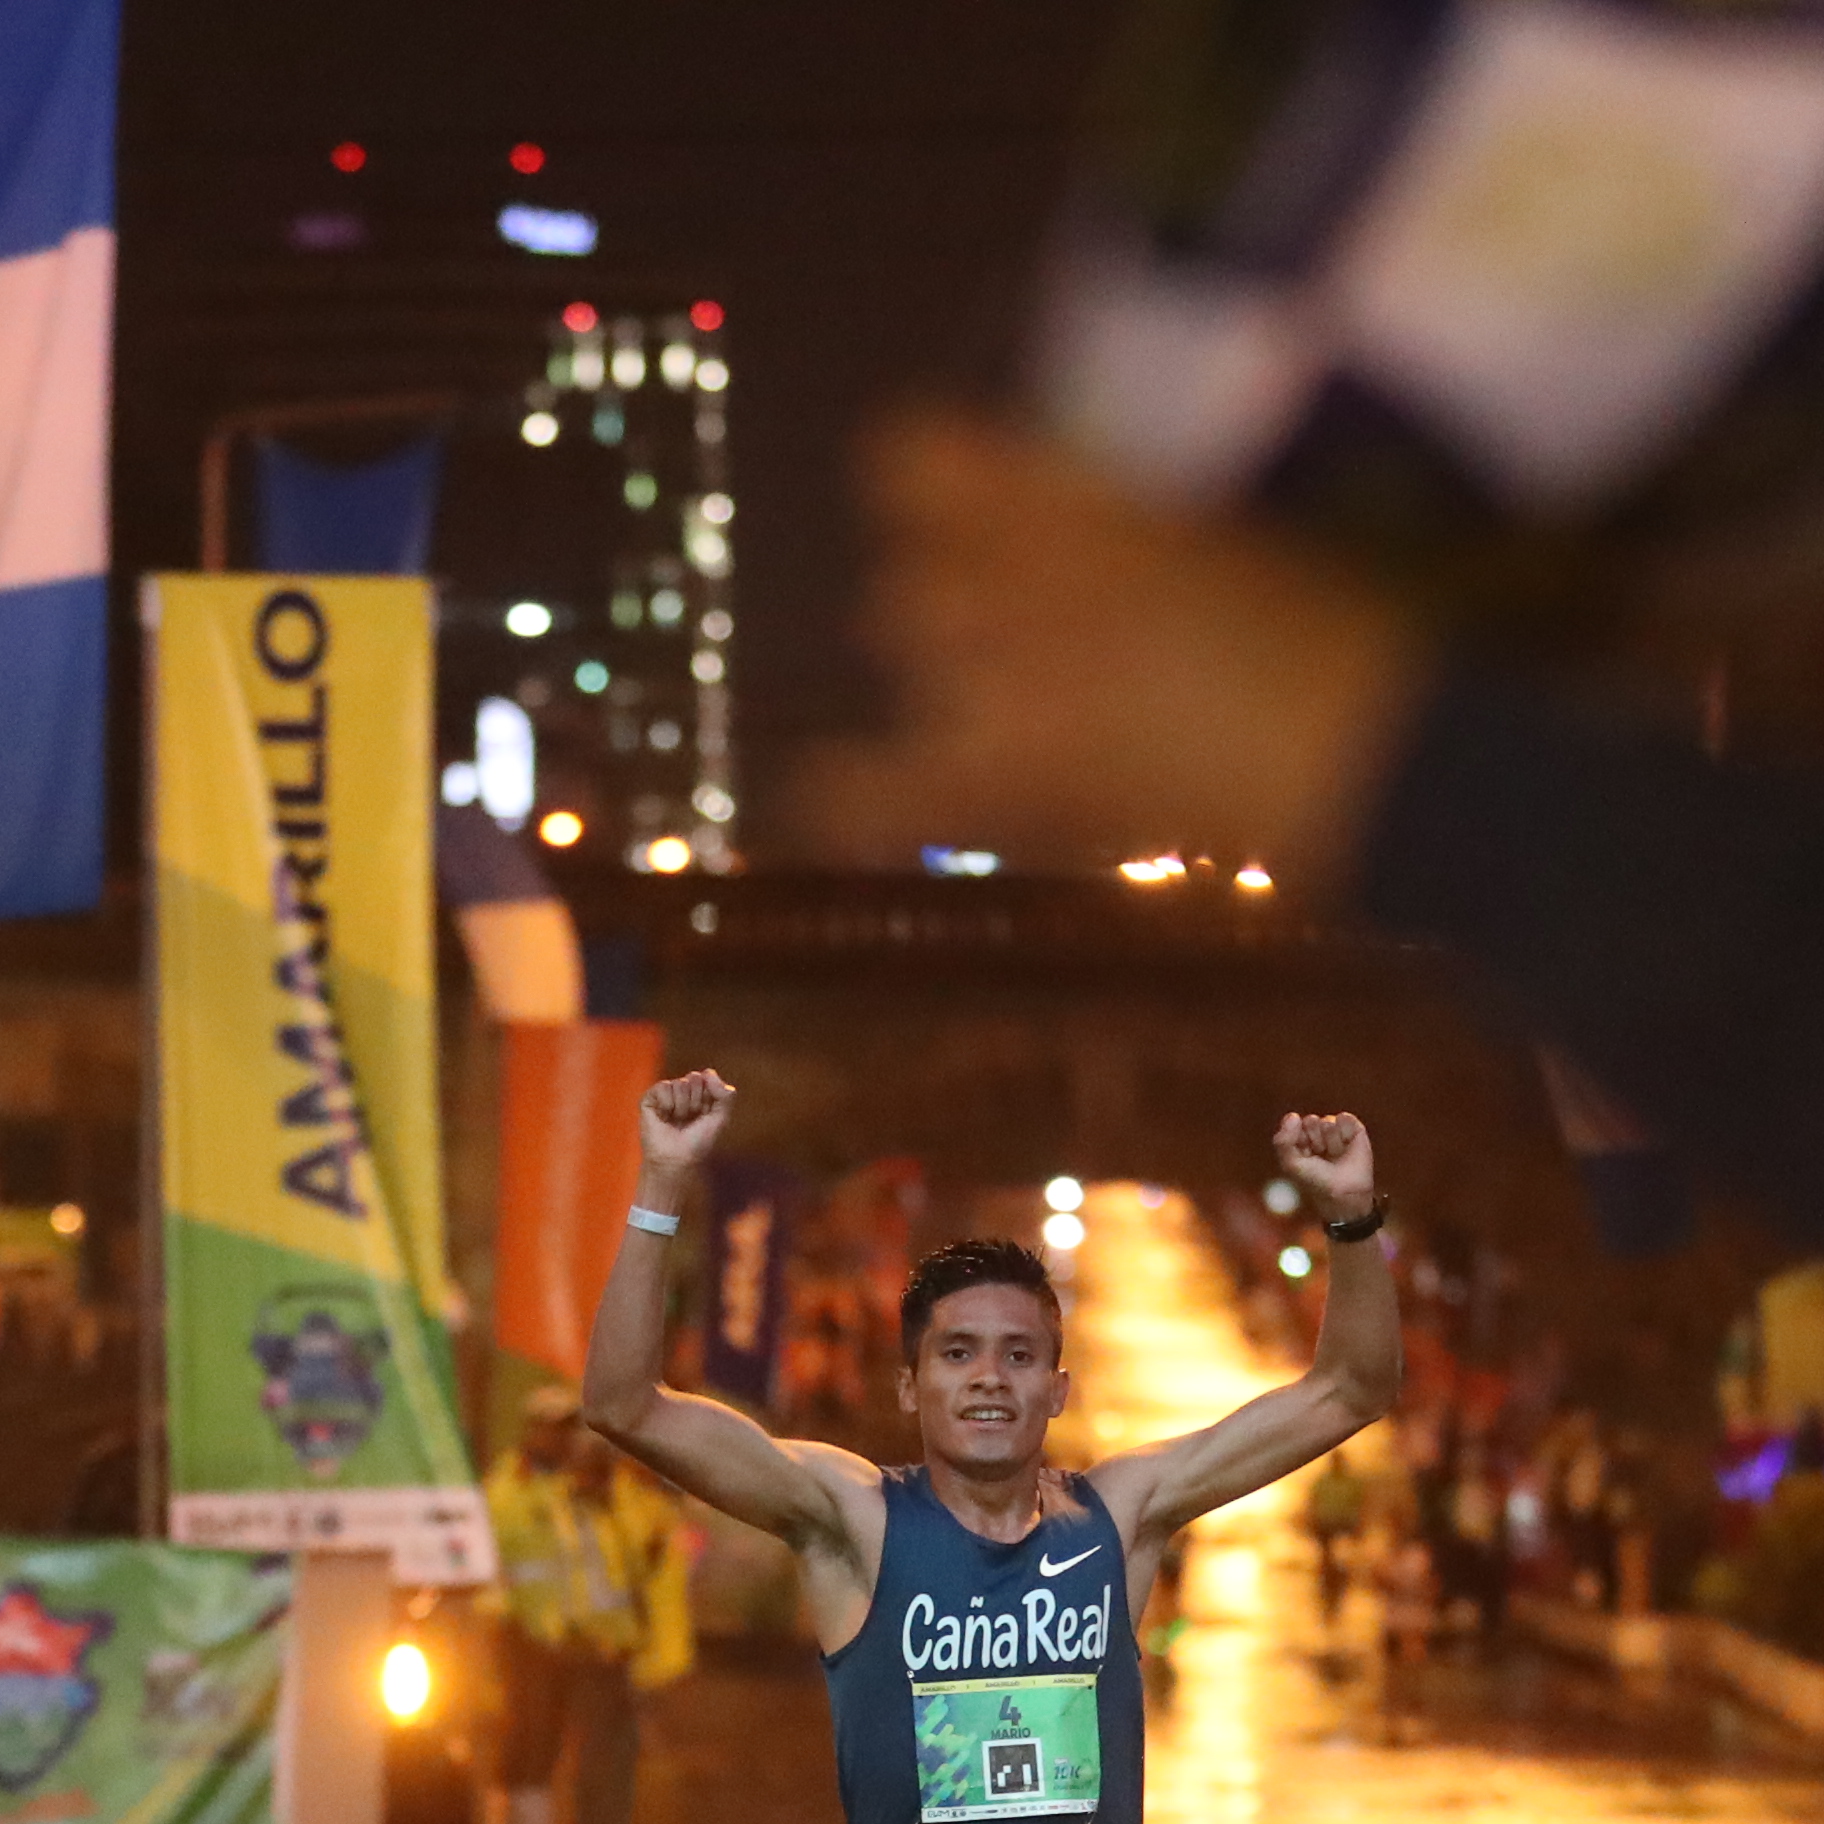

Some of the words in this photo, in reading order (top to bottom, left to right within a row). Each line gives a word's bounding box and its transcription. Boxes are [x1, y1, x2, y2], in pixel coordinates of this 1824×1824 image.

[254, 590, 369, 1223] AMARILLO
[902, 1593, 1019, 1671] Caña
[1022, 1584, 1111, 1664] Real
[990, 1727, 1031, 1740] MARIO
[999, 1695, 1021, 1726] 4
